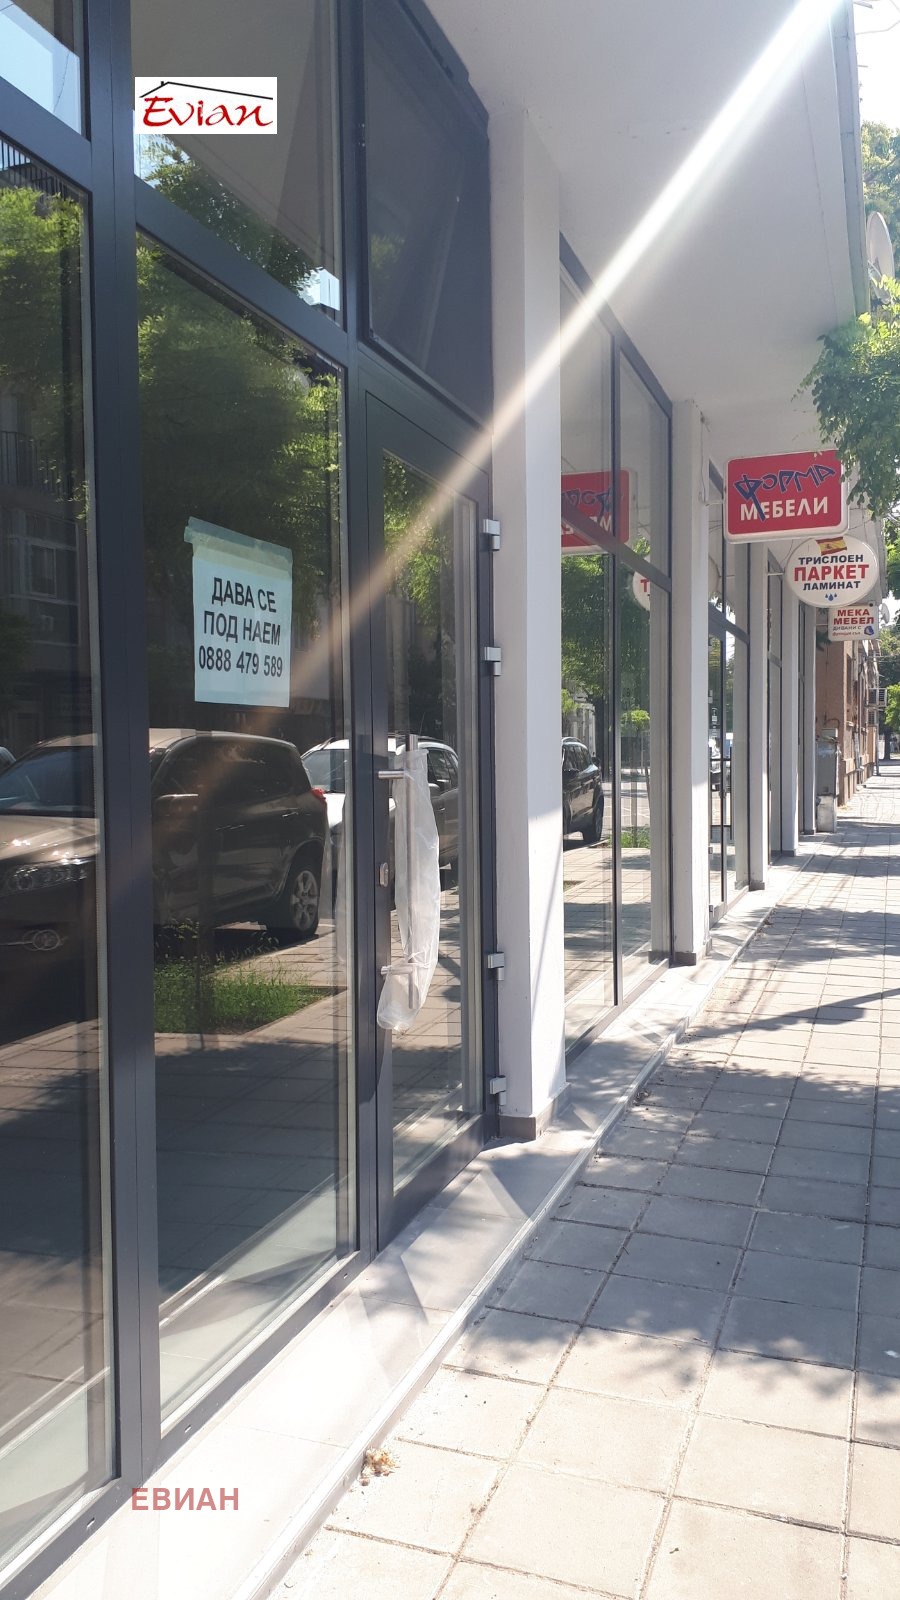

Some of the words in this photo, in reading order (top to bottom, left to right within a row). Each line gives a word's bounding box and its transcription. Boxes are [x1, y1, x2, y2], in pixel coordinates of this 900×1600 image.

[740, 497, 828, 521] МЕБЕЛИ
[798, 554, 864, 565] ТРИСЛОЕН
[794, 564, 869, 581] ПАРКЕТ
[212, 577, 254, 609] ДАВА
[257, 589, 277, 613] СЕ
[803, 581, 861, 591] ЛАМИНАТ
[204, 611, 238, 643] ПОД
[243, 618, 281, 645] НАЕМ
[833, 617, 874, 625] МЕБЕЛ
[199, 645, 232, 672] 0888
[236, 651, 259, 675] 479
[264, 655, 283, 678] 589
